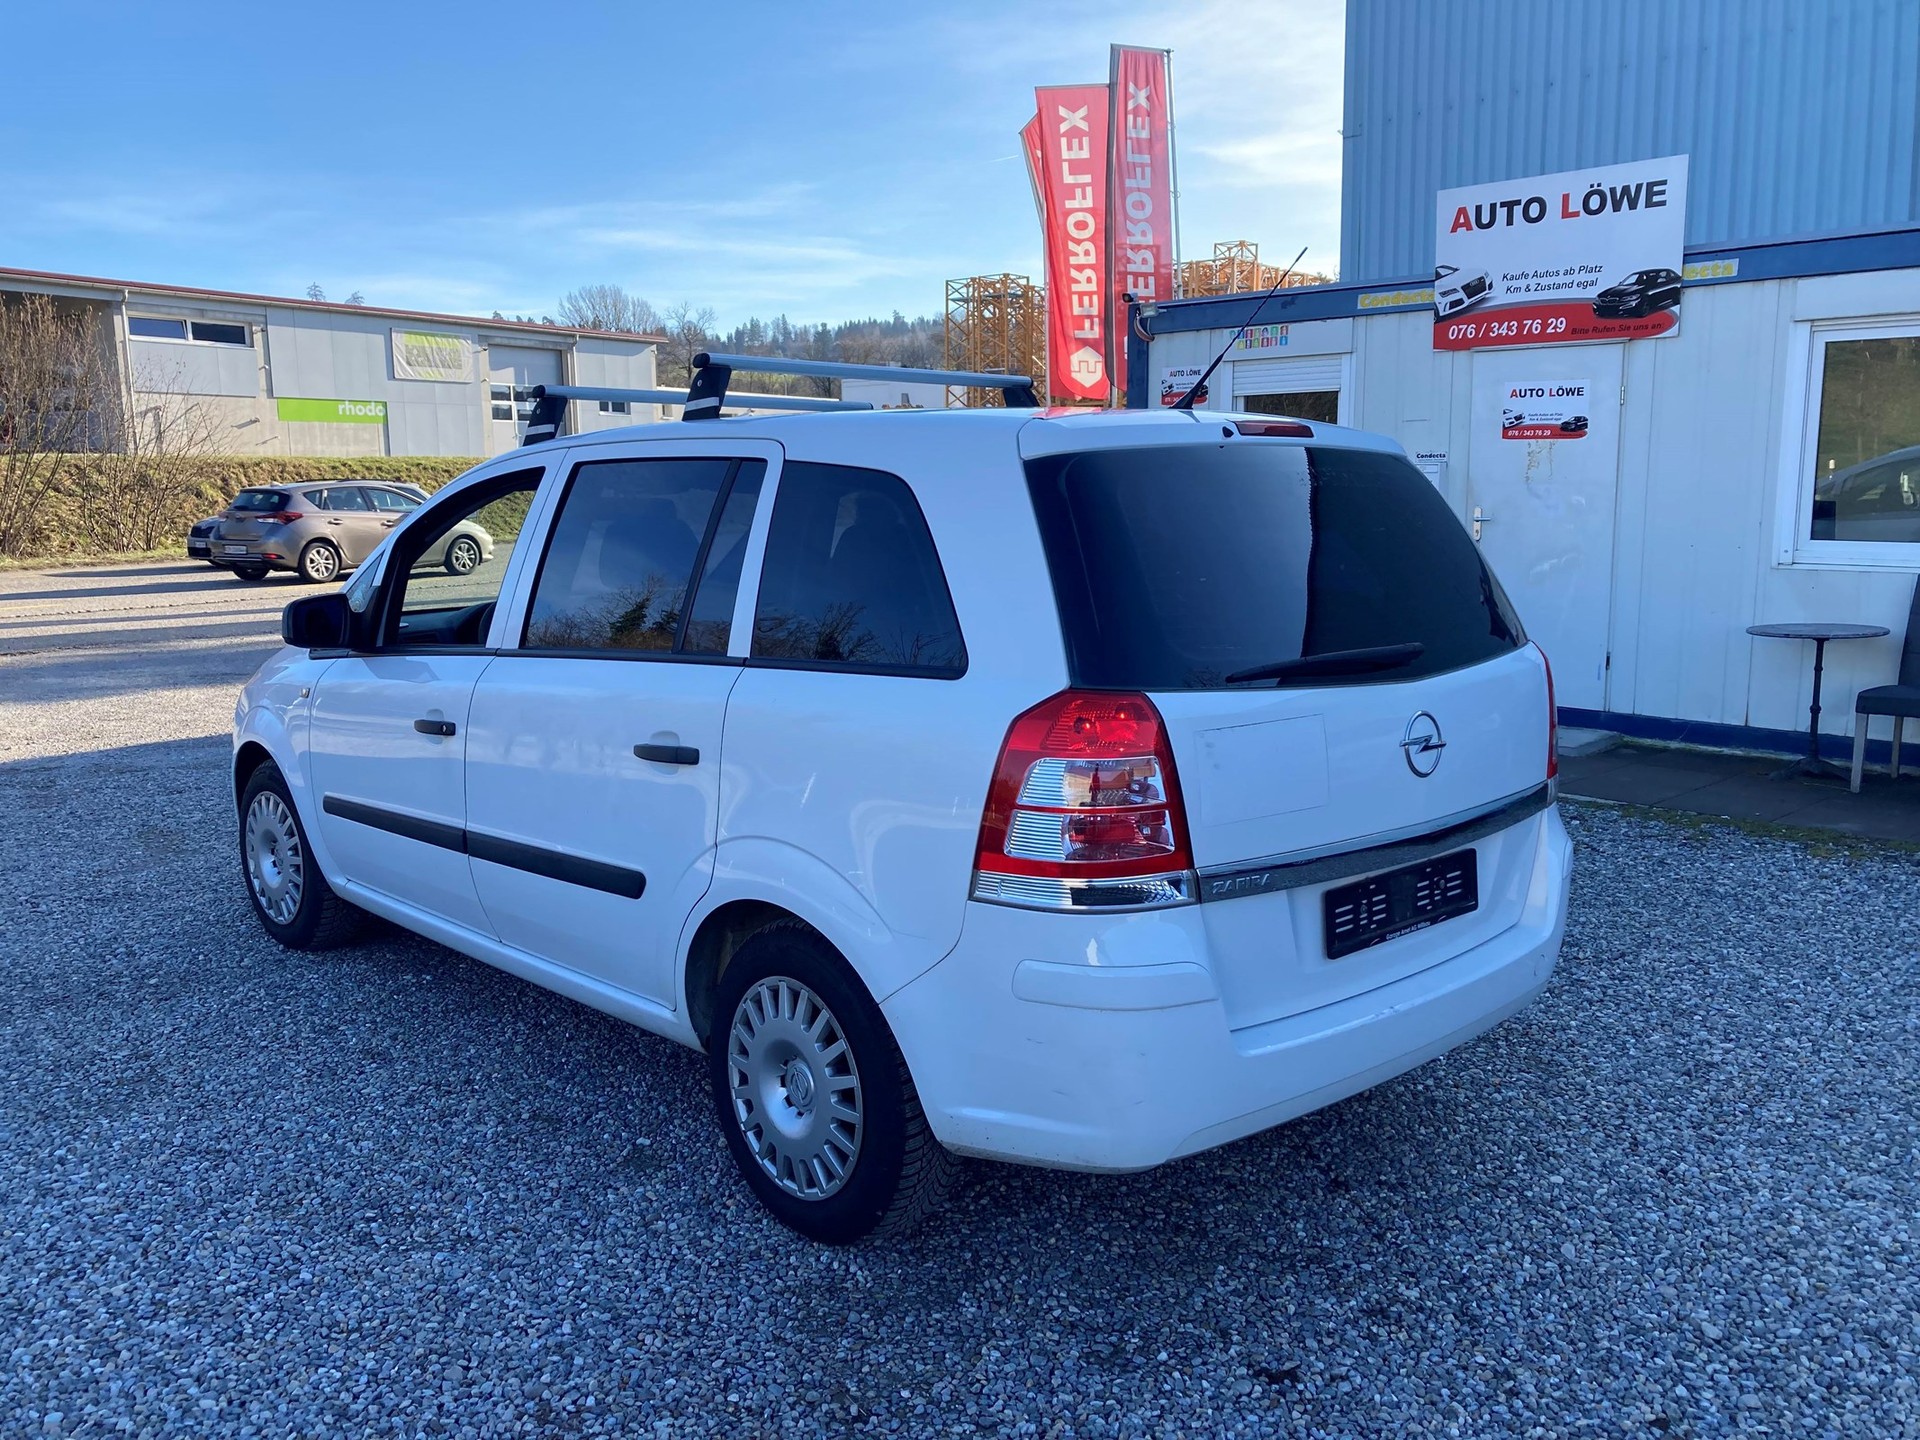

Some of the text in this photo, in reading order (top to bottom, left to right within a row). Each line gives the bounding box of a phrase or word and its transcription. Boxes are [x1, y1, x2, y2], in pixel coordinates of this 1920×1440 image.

[1450, 179, 1668, 233] AUTO LÖWE
[1502, 264, 1603, 282] Kaufe Autos ab Platz
[1505, 277, 1599, 294] Km & Zustand egal
[1448, 317, 1566, 340] 076 / 343 76 29
[1591, 325, 1616, 334] Rufen
[1618, 324, 1631, 332] Sie
[1633, 323, 1648, 331] uns
[1510, 385, 1585, 399] AUTO LÖWE
